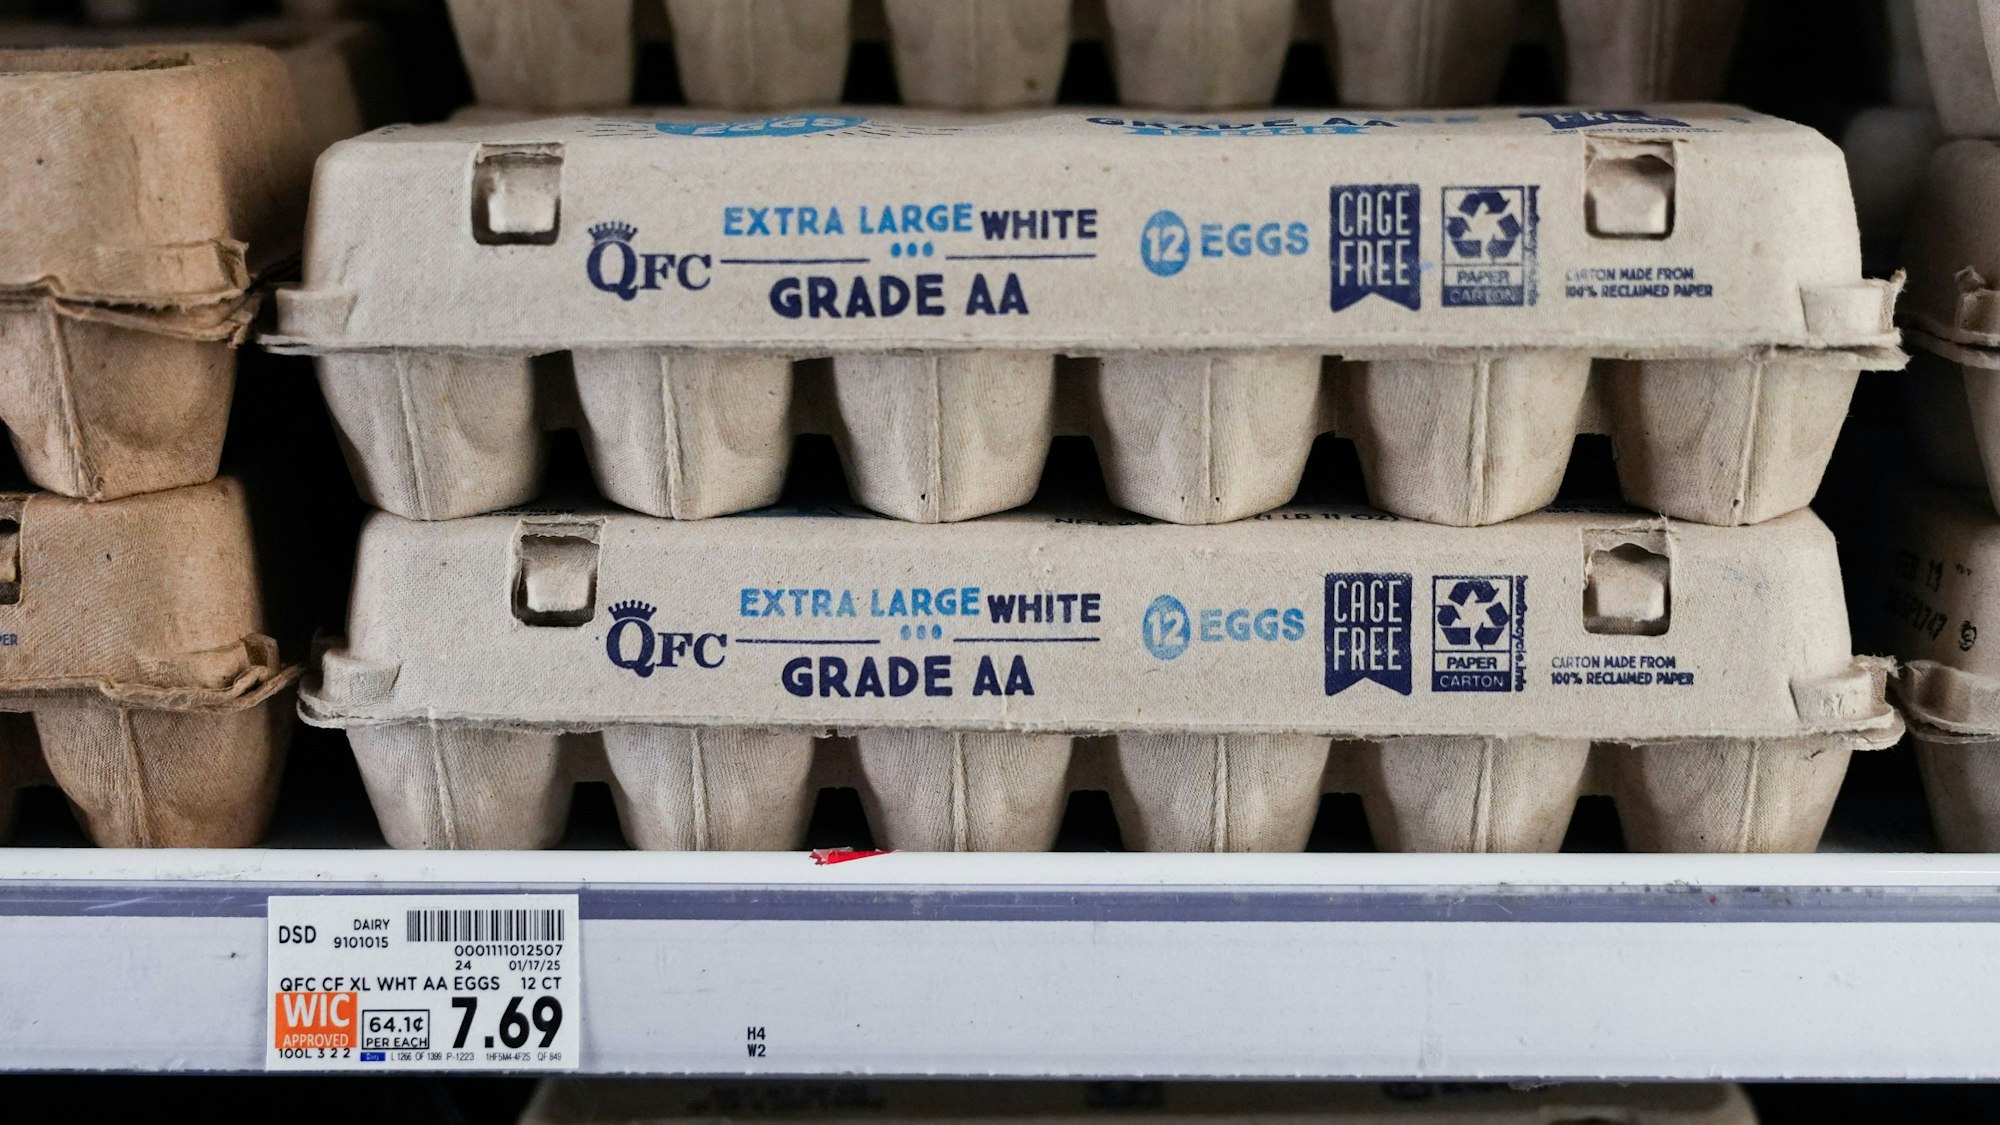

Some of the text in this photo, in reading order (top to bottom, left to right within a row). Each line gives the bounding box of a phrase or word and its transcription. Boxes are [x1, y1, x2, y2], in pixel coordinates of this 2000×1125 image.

[1341, 191, 1409, 236] CAGE
[724, 204, 1097, 240] EXTRA LARGE WHITE
[1147, 222, 1309, 261] 12 EGGS
[587, 239, 711, 301] QFC
[1341, 242, 1409, 285] FREE
[1458, 271, 1509, 282] PAPER
[1620, 268, 1652, 280] MADE
[1657, 268, 1694, 280] FROM
[769, 273, 1029, 319] GRADE AA
[1450, 289, 1516, 303] CARTON
[1566, 284, 1712, 298] 100% RECLAIMED PAPER
[740, 587, 1100, 623] EXTRA LARGE WHITE
[1334, 576, 1402, 622] CAGE
[1145, 608, 1305, 648] 12 EGGS
[606, 617, 727, 678] QFC
[1334, 627, 1401, 670] FREE
[1447, 657, 1497, 669] PAPER
[1552, 656, 1676, 669] CARTON MADE FROM
[782, 655, 1034, 697] GRADE AA
[1440, 675, 1503, 687] CARTON
[1551, 672, 1694, 685] 100% RECLAIMED PAPER
[354, 919, 389, 930] DAIRY
[279, 926, 316, 943] DSD
[334, 937, 388, 948] 9101015
[455, 945, 562, 956] 0001111012507
[456, 960, 560, 971] 24 01/17/25
[281, 976, 561, 991] QFC CF XL WHT AA EGGS 12 CT
[283, 993, 349, 1027] WIC
[370, 1017, 423, 1032] 64.1¢
[452, 996, 562, 1048] 7.69
[283, 1034, 348, 1047] APPROVED
[748, 1027, 765, 1040] H4
[367, 1038, 427, 1048] PER EACH
[318, 1048, 324, 1058] 3
[331, 1048, 337, 1058] 2
[343, 1048, 350, 1058] 2
[415, 1051, 425, 1061] OF
[446, 1051, 475, 1062] P-1223
[748, 1044, 765, 1057] W2
